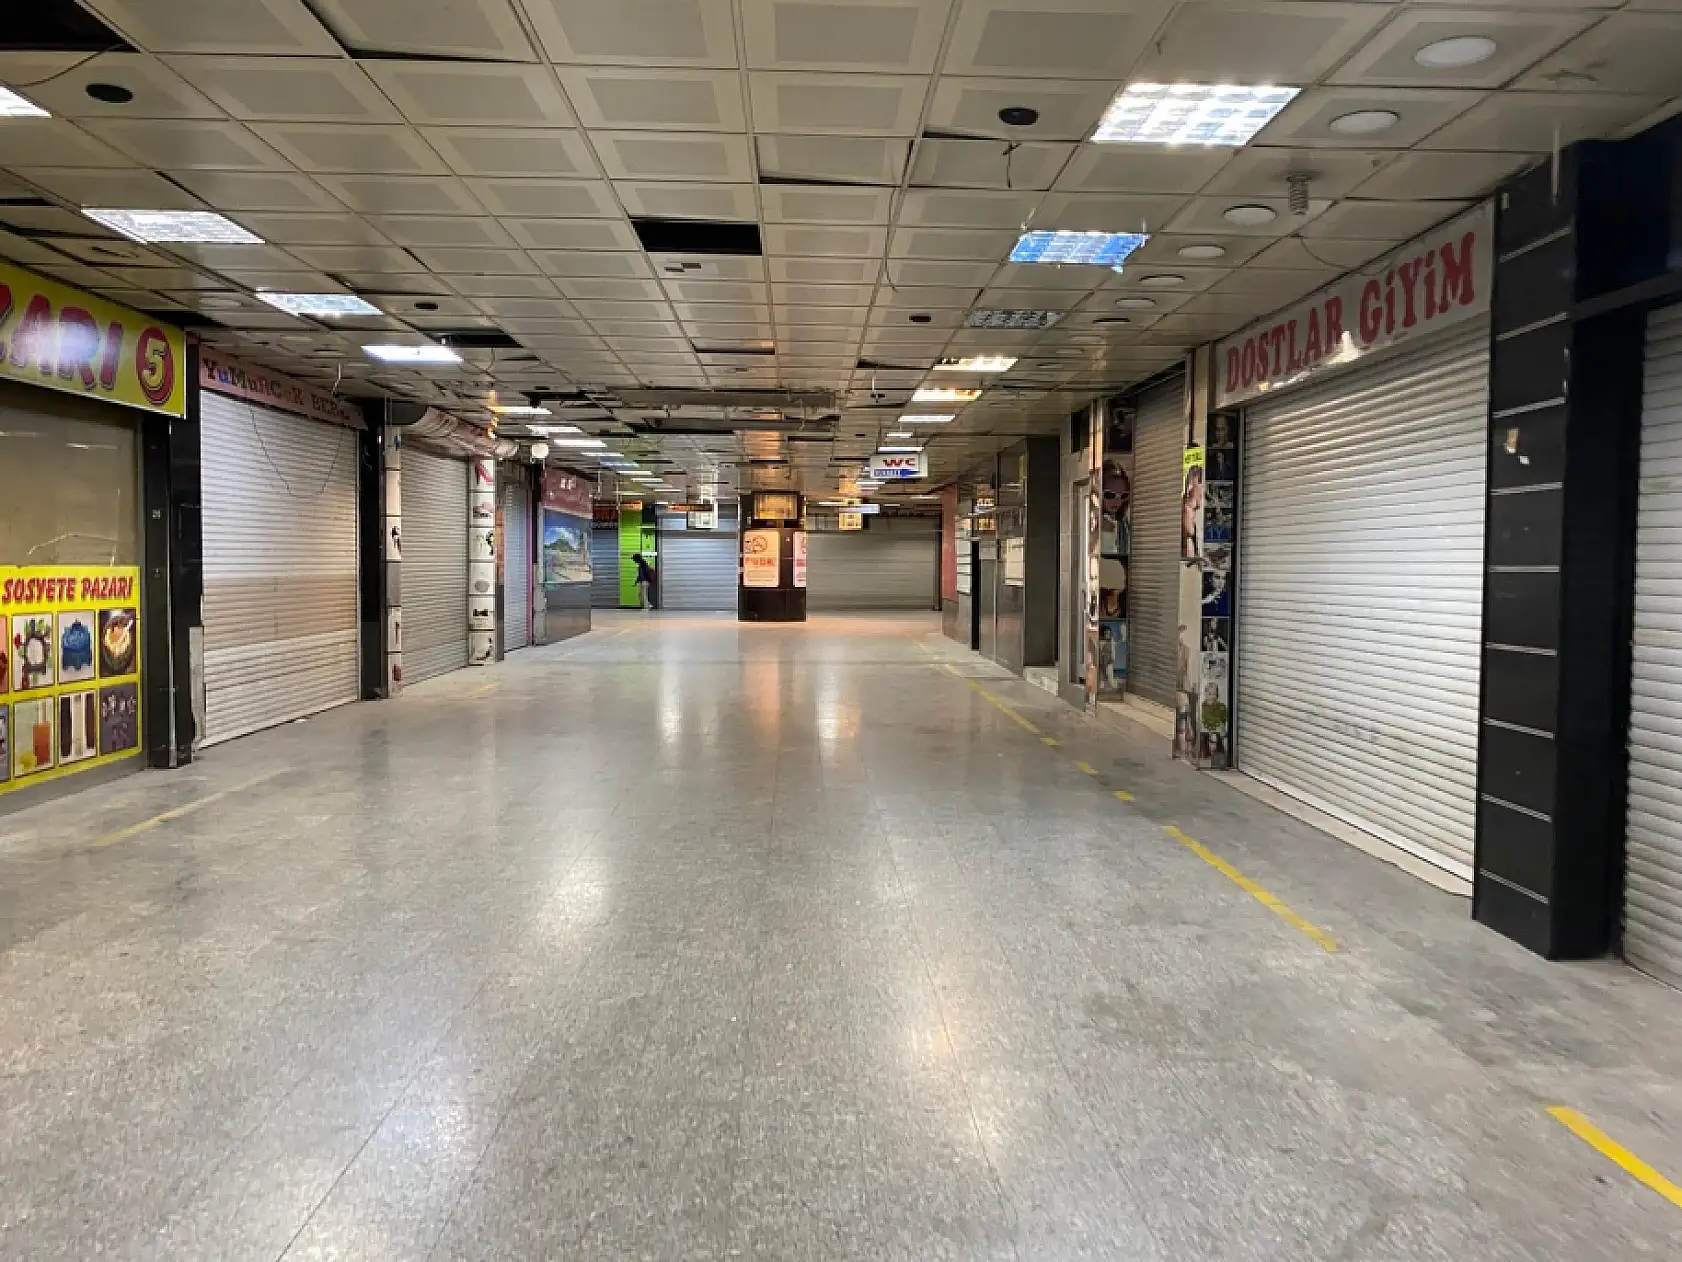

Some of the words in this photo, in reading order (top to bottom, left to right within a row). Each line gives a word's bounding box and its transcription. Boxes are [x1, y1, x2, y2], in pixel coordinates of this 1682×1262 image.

[141, 335, 169, 394] 5
[1226, 294, 1343, 394] DOSTLAR
[882, 457, 916, 467] WC
[2, 575, 78, 604] SOSYETE
[81, 575, 134, 601] PAZARI
